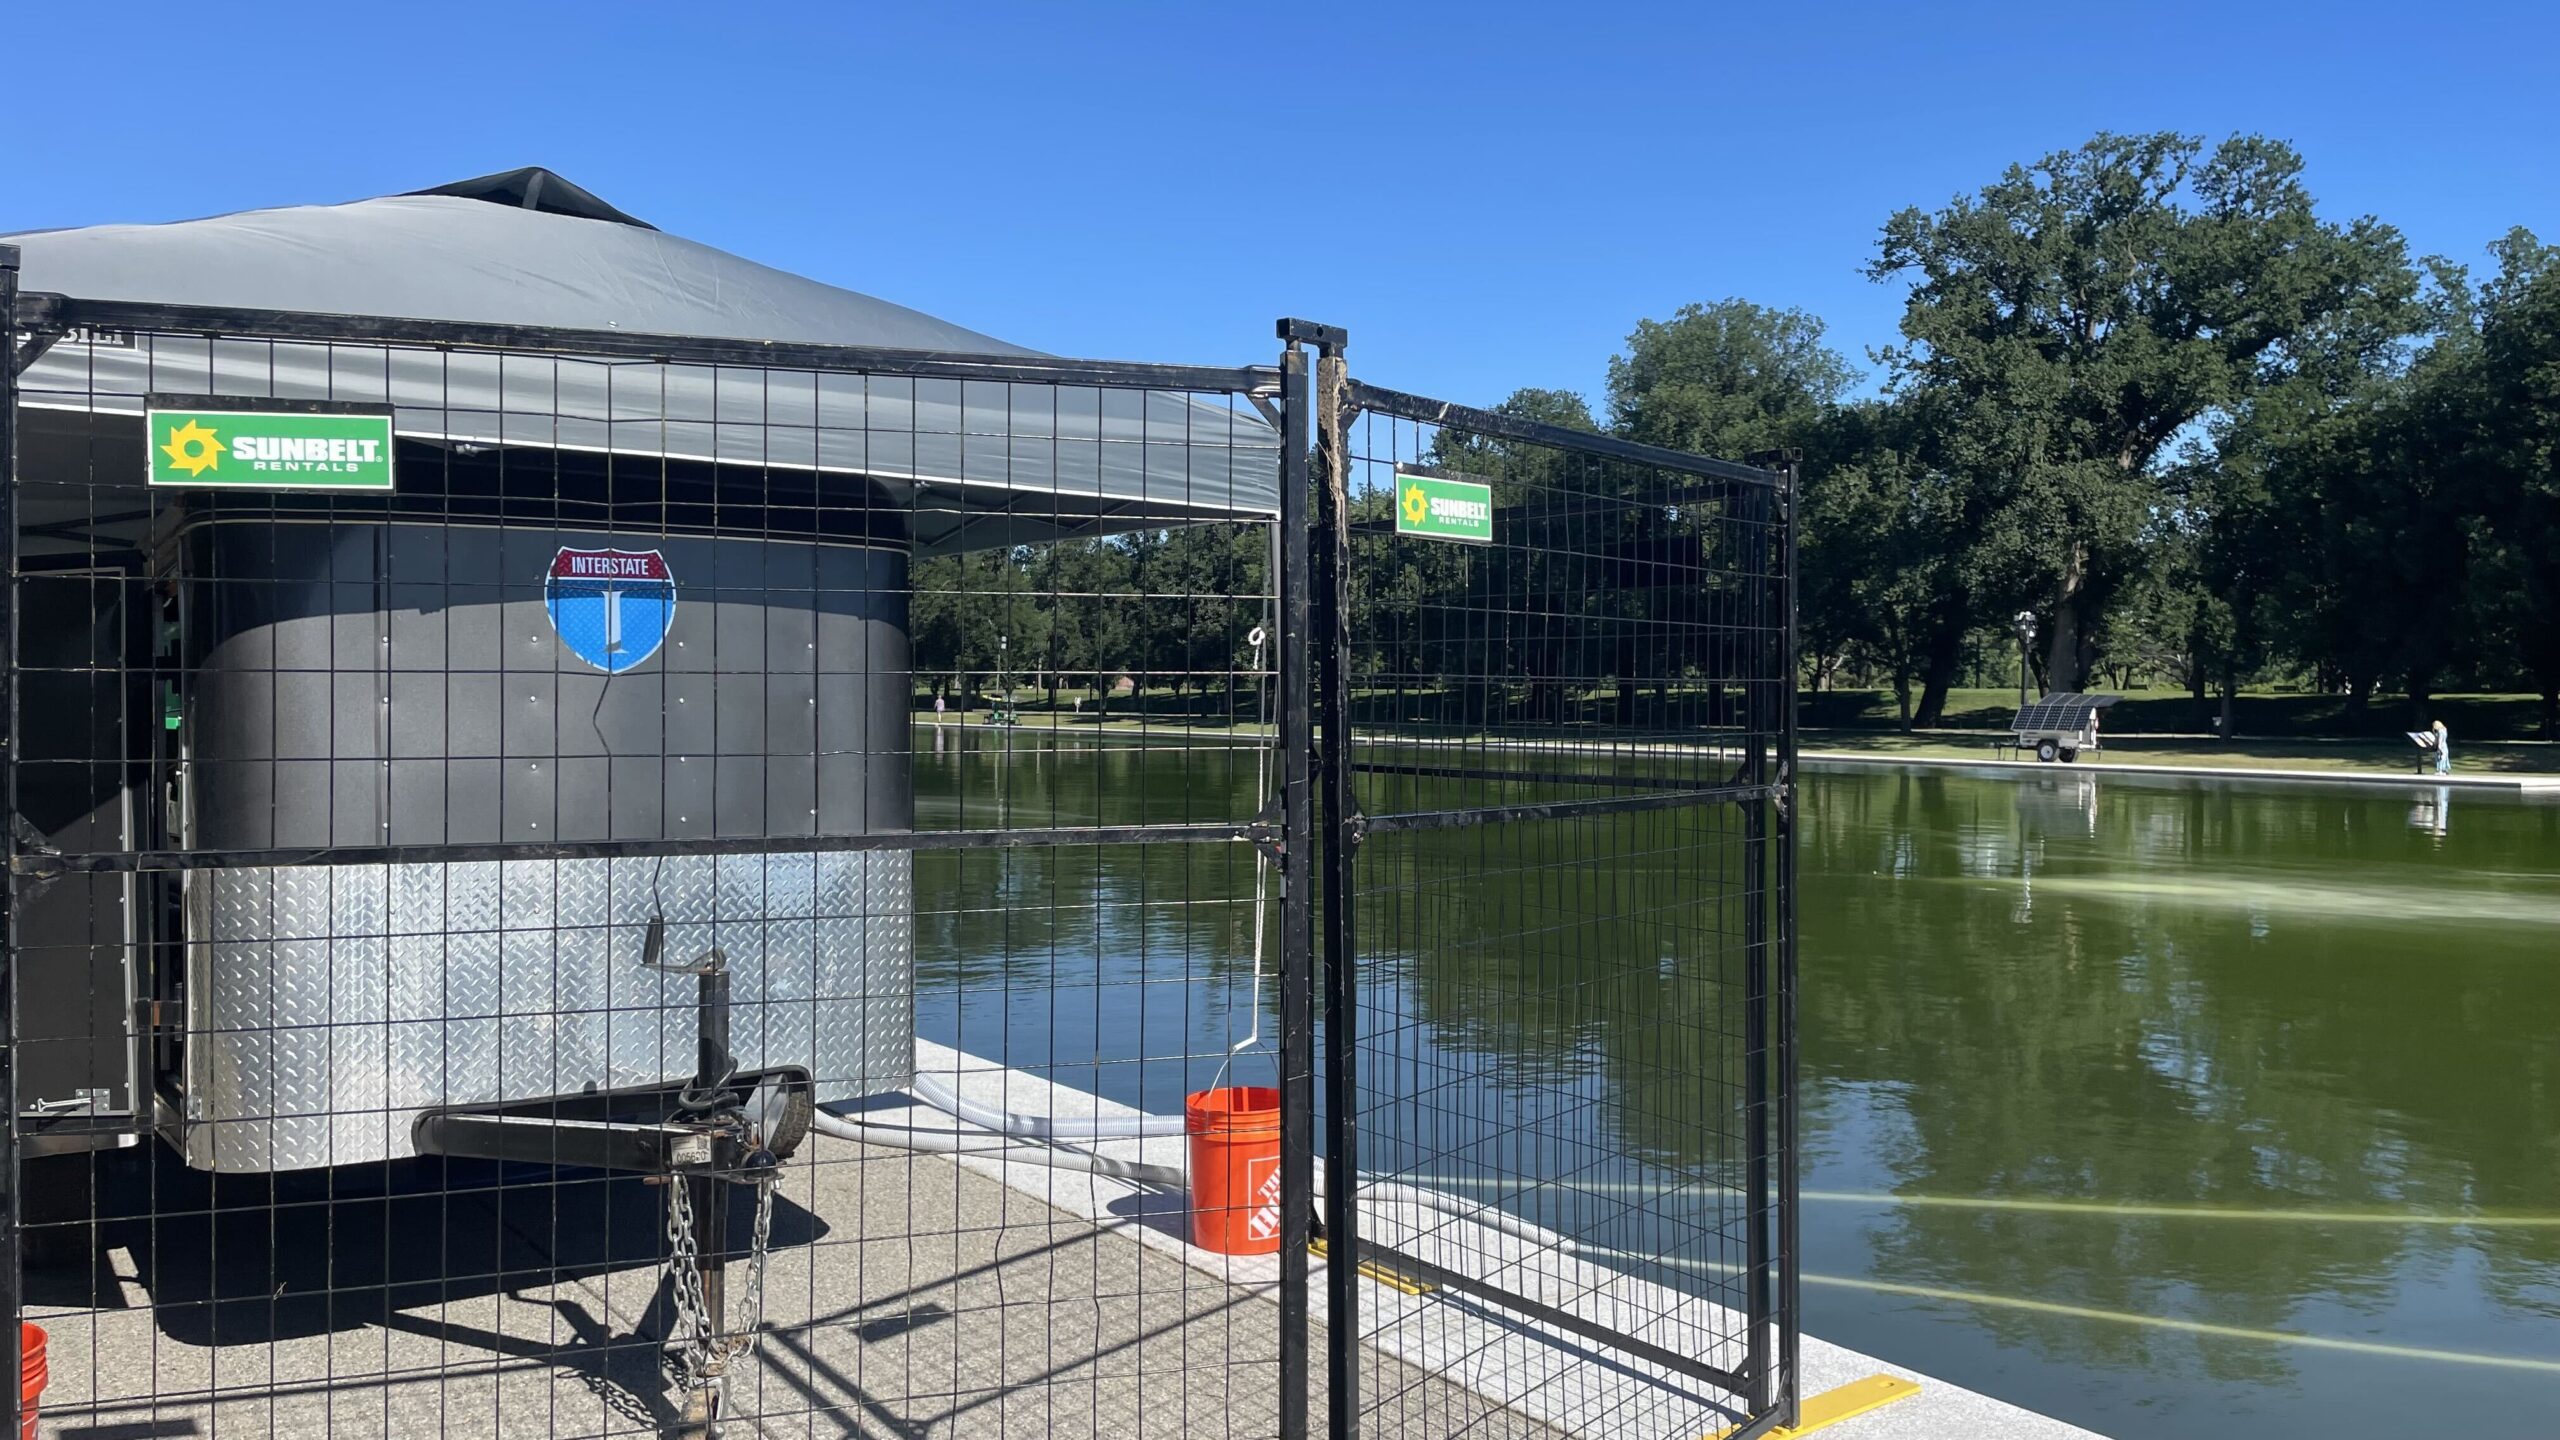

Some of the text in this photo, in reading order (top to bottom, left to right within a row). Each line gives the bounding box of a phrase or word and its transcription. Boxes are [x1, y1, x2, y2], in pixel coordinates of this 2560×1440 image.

[232, 436, 380, 463] SUNBELT
[253, 462, 359, 473] RENTALS
[1430, 497, 1487, 521] SUNBELT
[1438, 516, 1480, 528] RENTALS
[571, 556, 649, 575] INTERSTATE
